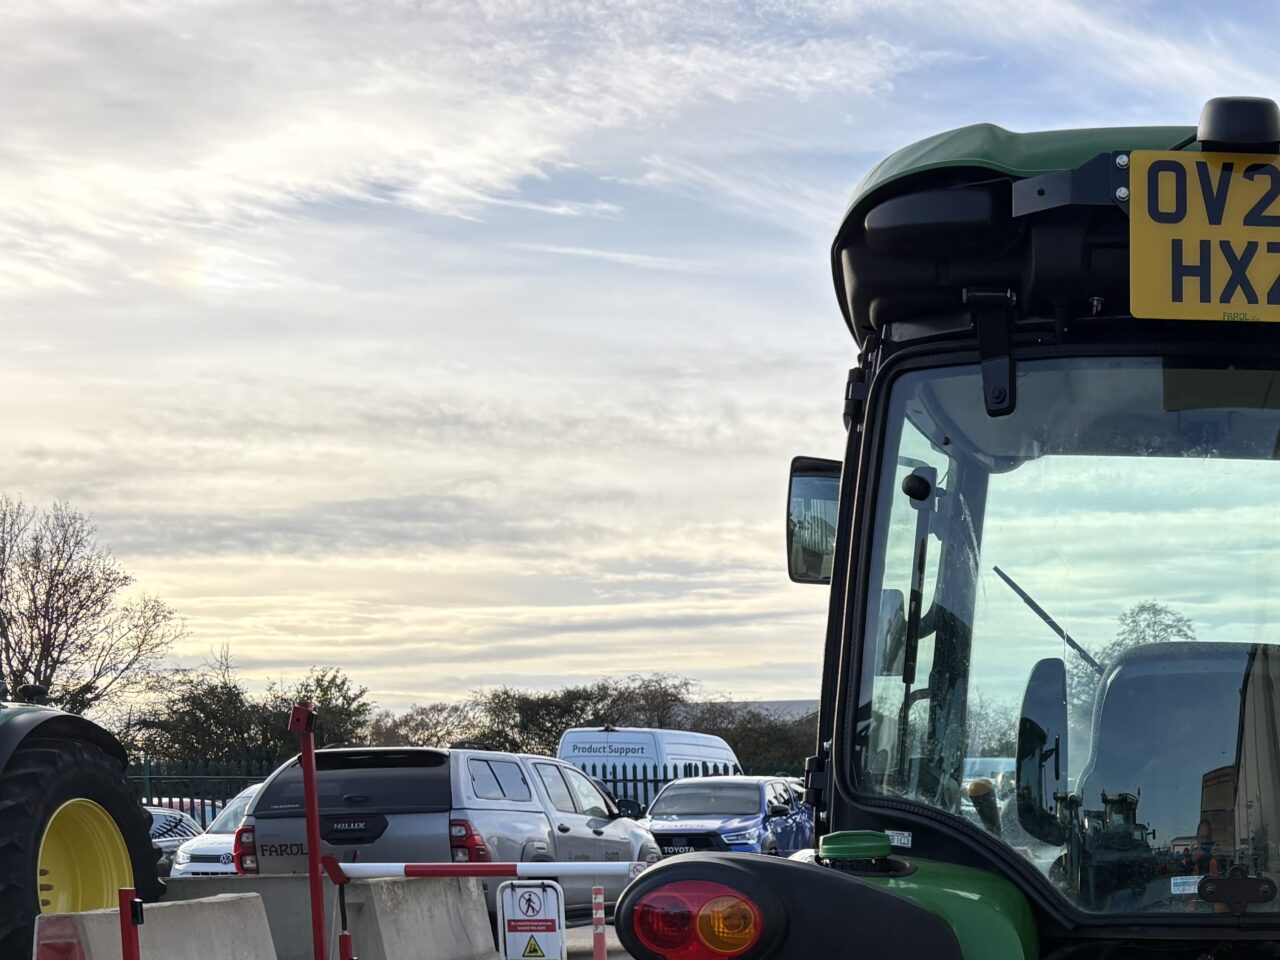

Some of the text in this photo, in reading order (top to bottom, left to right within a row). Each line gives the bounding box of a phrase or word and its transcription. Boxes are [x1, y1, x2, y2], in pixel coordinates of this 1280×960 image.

[572, 744, 645, 756] Product Support
[333, 822, 366, 830] HILUX
[260, 843, 309, 857] FAROL
[664, 846, 695, 854] TOYOTA
